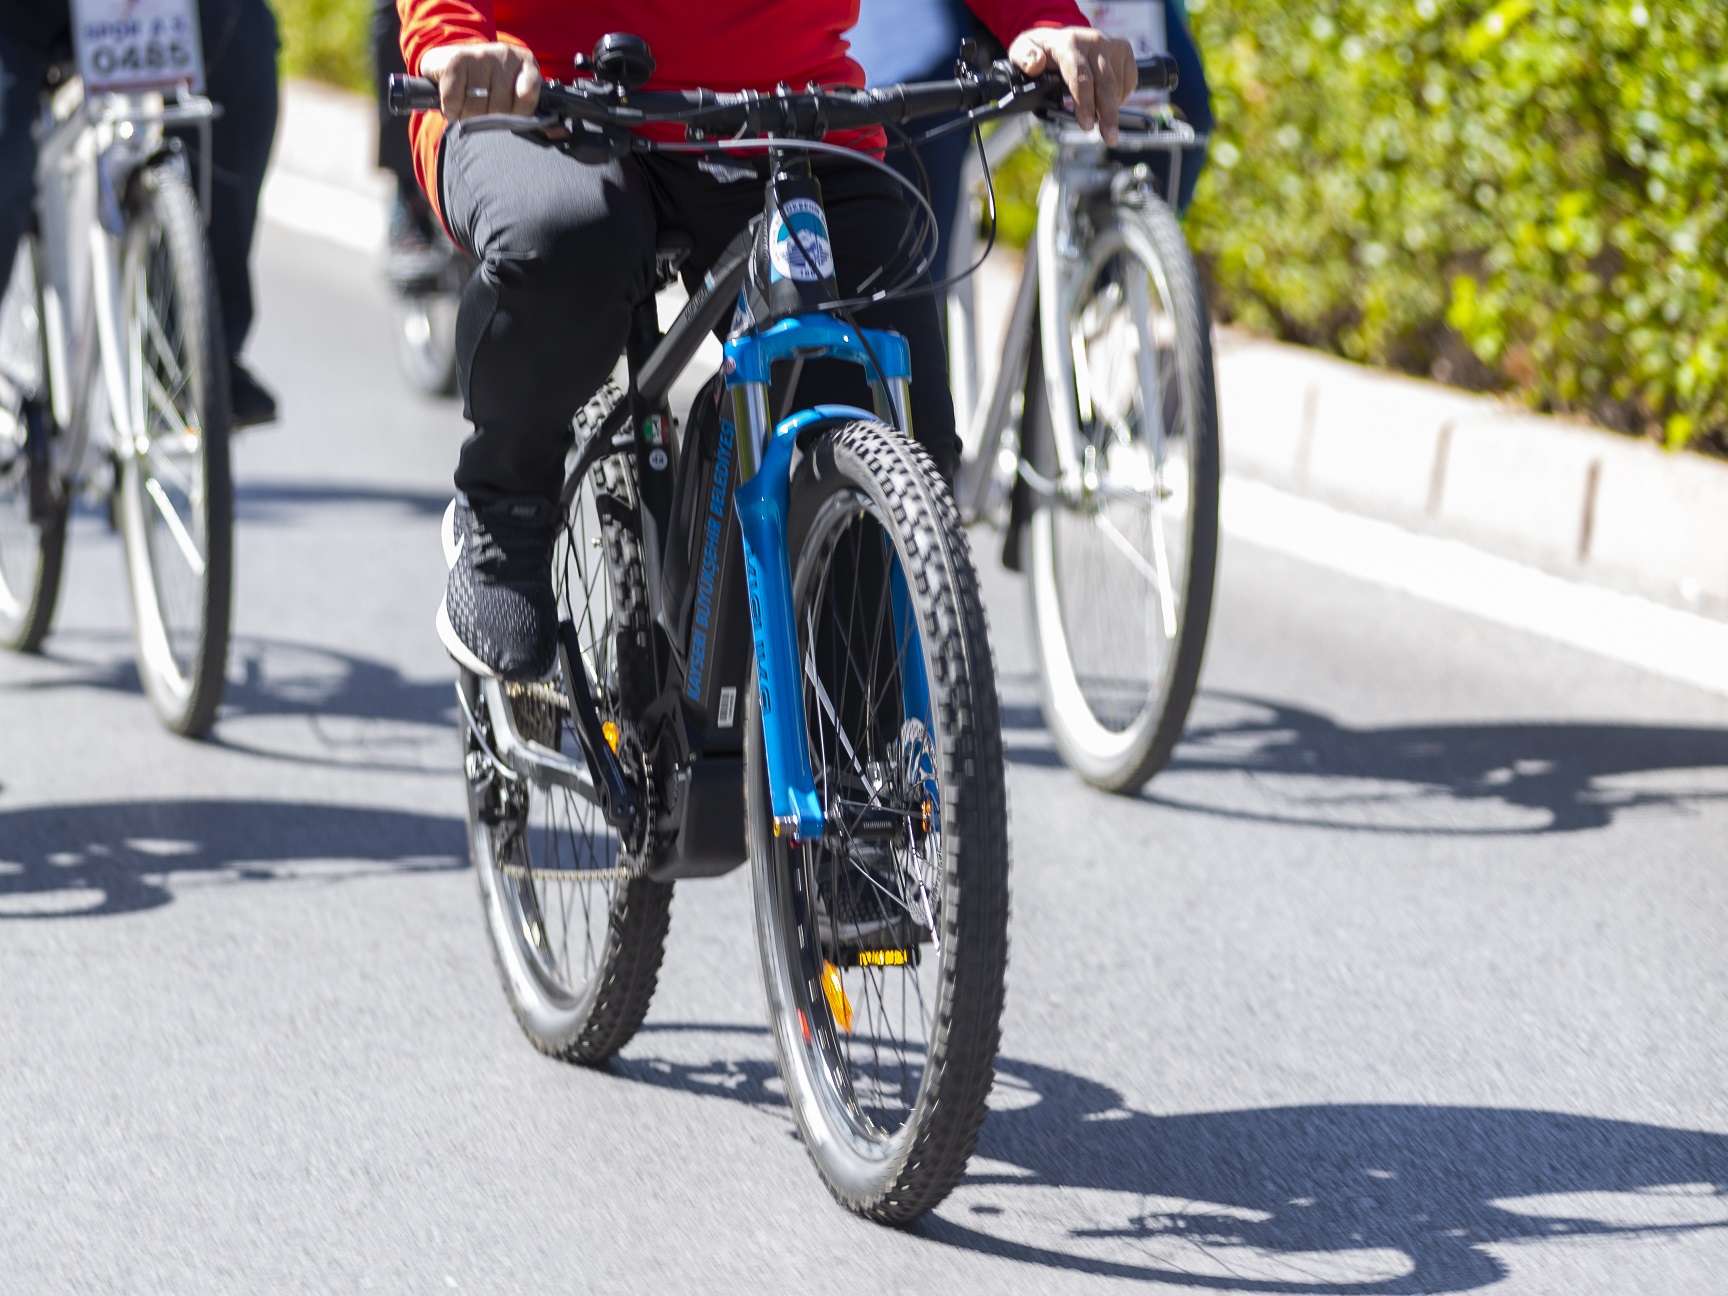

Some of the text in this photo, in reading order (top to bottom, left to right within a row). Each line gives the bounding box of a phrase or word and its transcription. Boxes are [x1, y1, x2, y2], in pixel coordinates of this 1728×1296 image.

[91, 42, 191, 75] 0485
[687, 415, 735, 702] KAYSERİ BÜYÜKŞEHİR BELEDİYESİ
